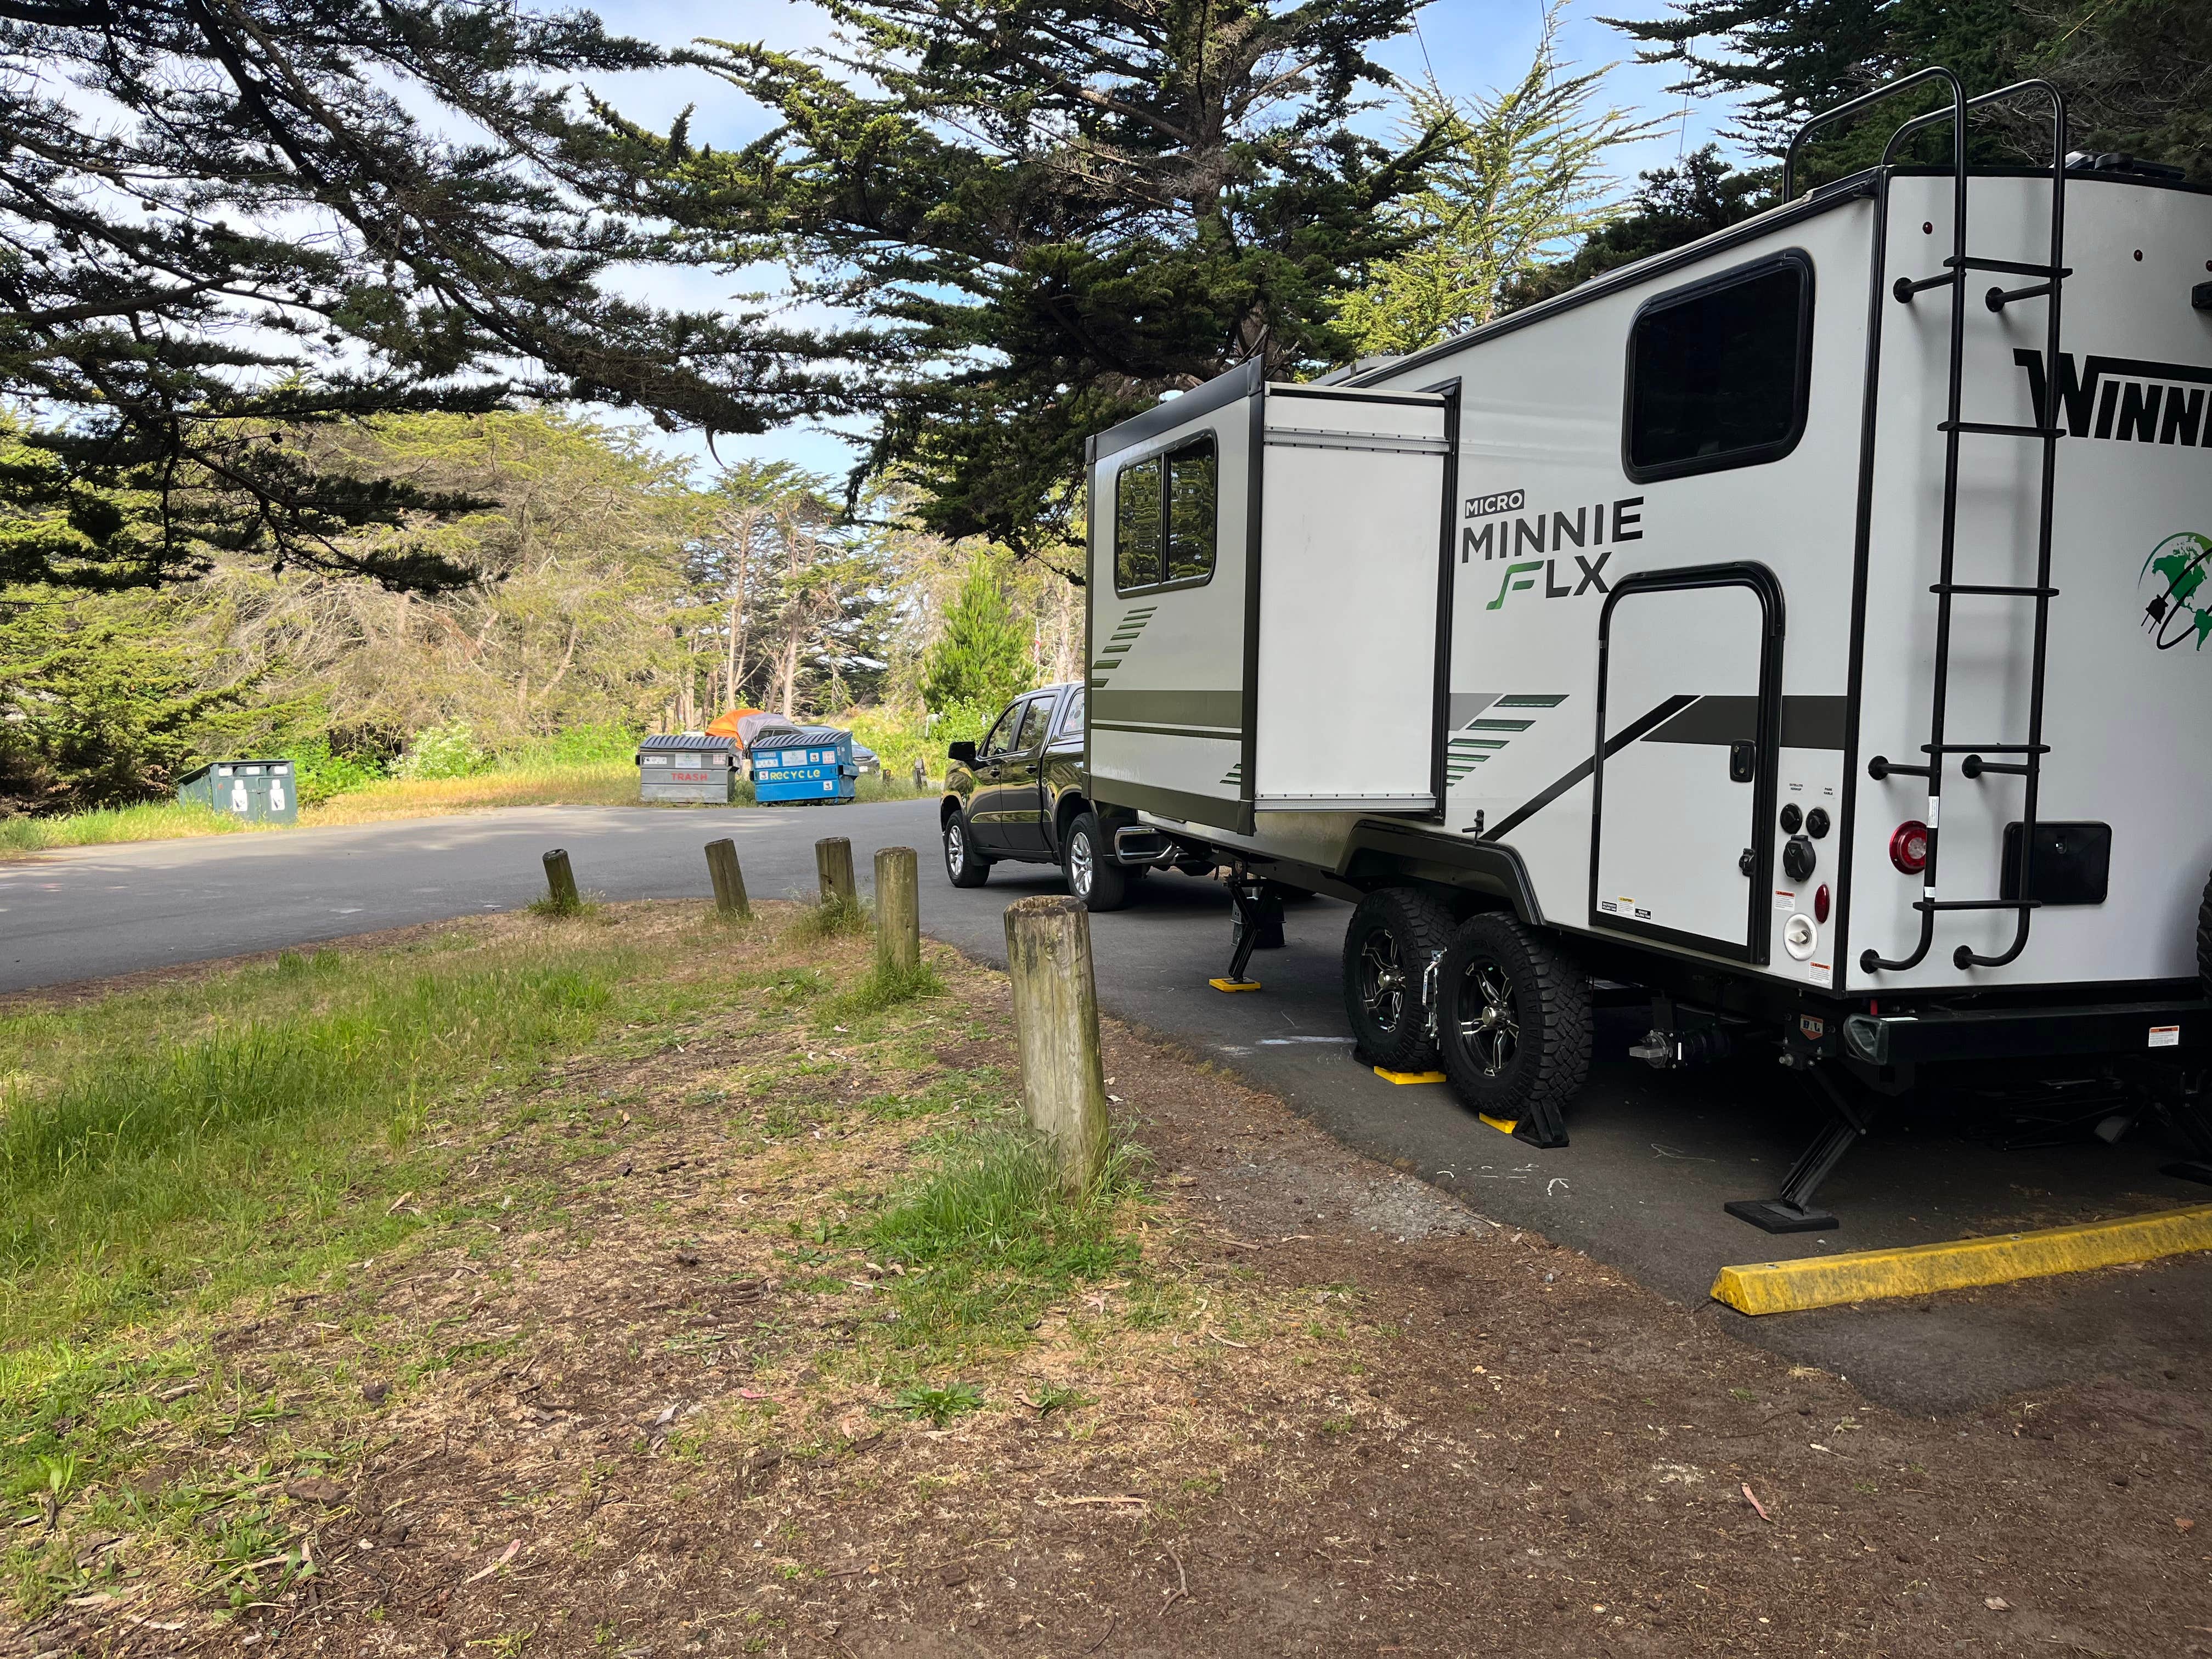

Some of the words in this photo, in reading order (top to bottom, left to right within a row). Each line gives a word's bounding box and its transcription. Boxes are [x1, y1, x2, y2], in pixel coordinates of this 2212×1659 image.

[2013, 348, 2212, 448] WINN
[1465, 492, 1523, 517] MICRO
[1462, 496, 1644, 563] MINNIE
[672, 772, 707, 781] TRASH
